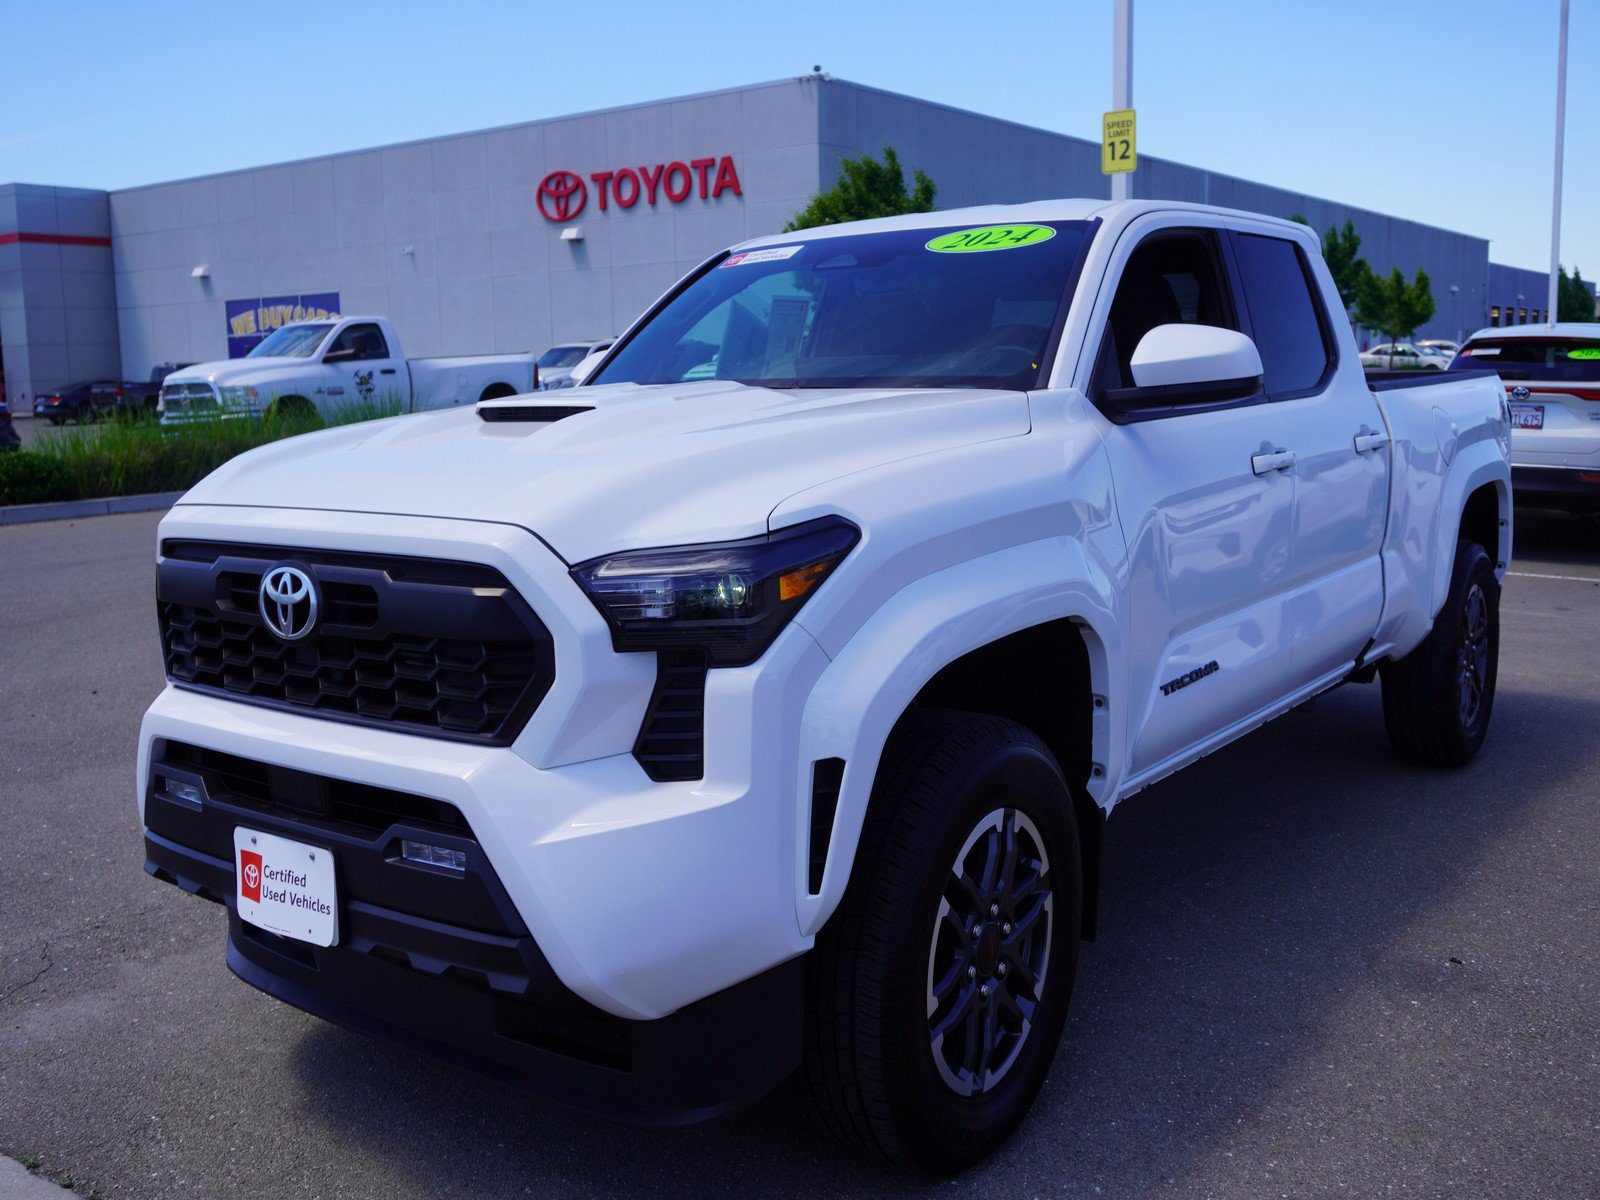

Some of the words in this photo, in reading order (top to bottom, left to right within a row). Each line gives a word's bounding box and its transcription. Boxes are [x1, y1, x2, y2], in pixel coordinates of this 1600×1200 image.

[1106, 119, 1133, 130] SPEED
[1108, 128, 1131, 138] LIMIT
[1108, 139, 1131, 161] 12
[590, 155, 742, 212] TOYOTA
[940, 227, 1040, 250] 2024
[229, 310, 257, 337] WE
[257, 304, 294, 330] BUY
[1511, 414, 1541, 426] IL675
[1159, 659, 1220, 696] TACOMA
[263, 865, 307, 888] Certified
[262, 885, 287, 903] Used
[289, 891, 331, 915] Vehicles
